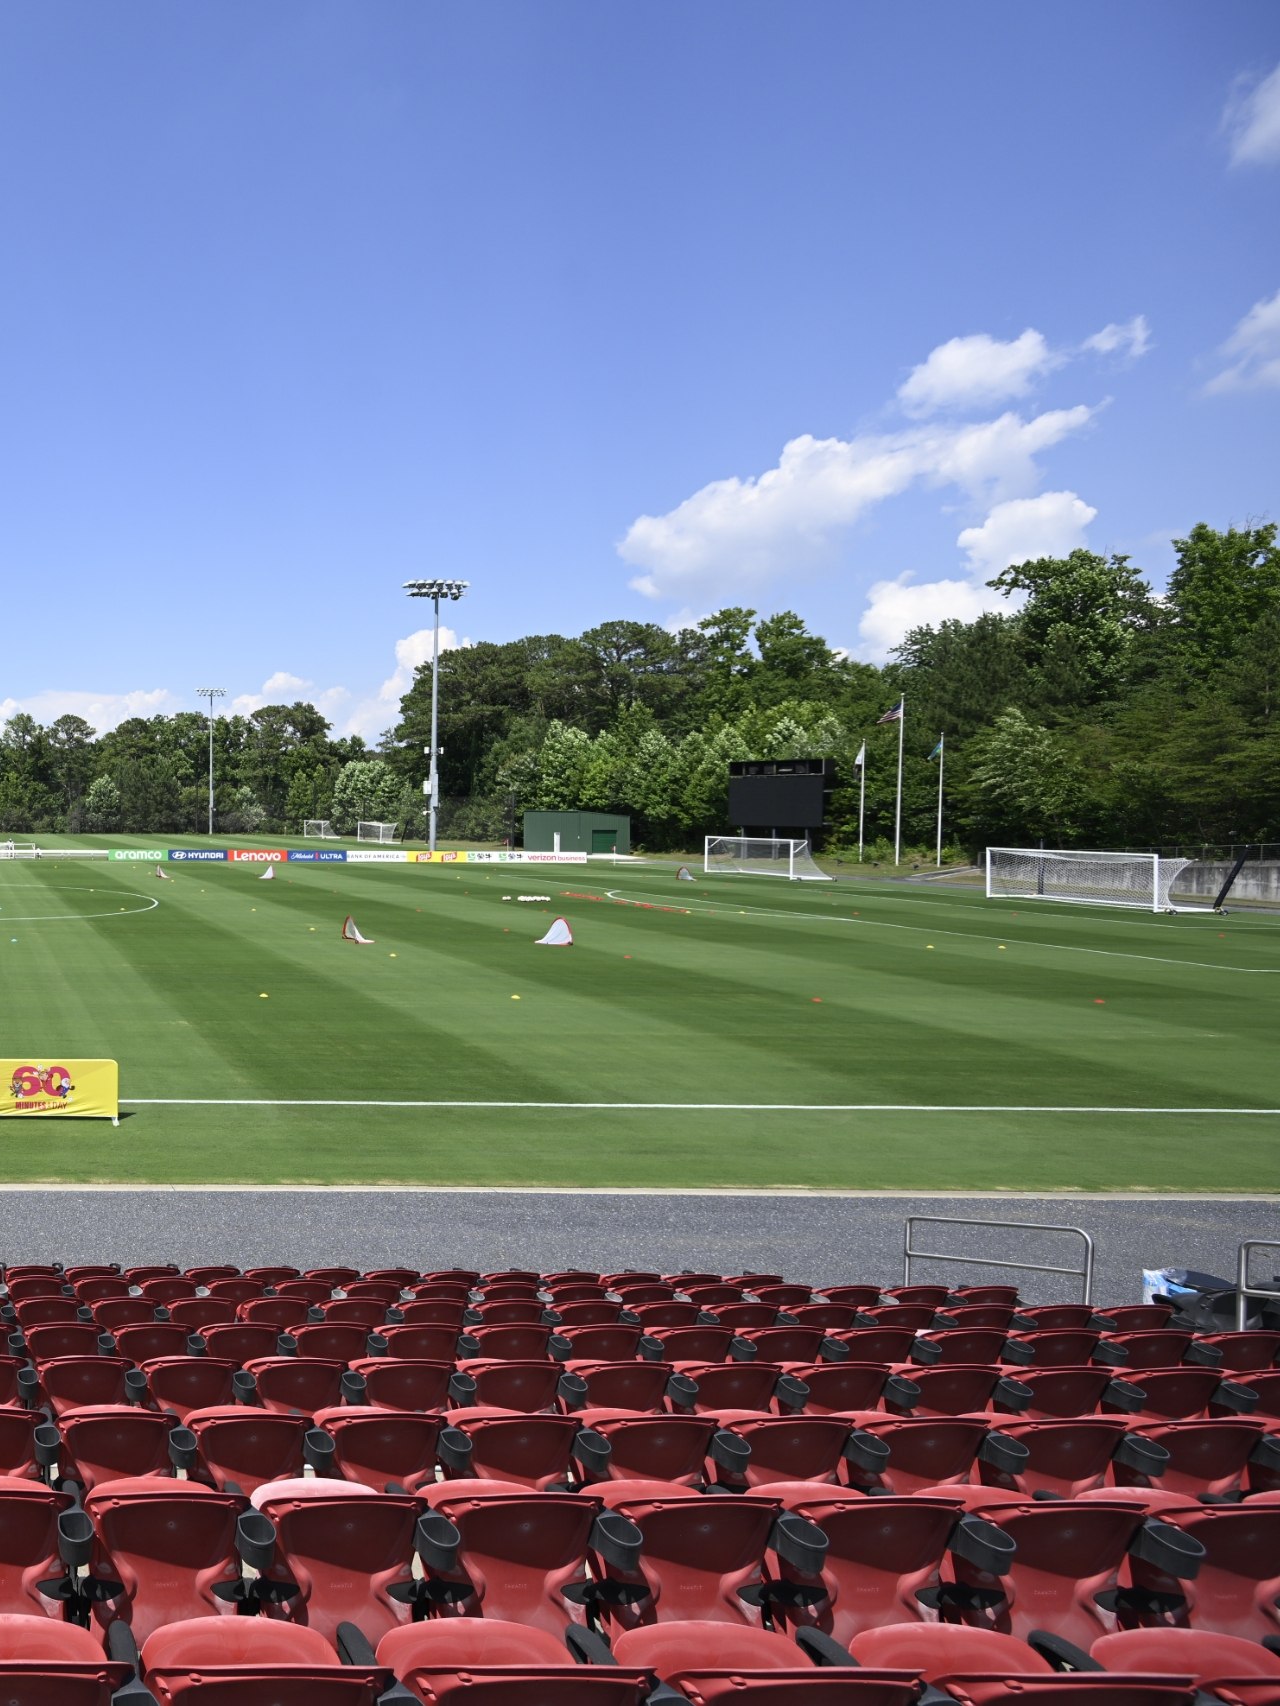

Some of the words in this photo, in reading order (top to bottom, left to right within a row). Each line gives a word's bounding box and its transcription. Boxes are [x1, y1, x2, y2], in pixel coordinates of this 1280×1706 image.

[115, 851, 162, 860] aramco
[233, 850, 281, 861] Lenovo
[12, 1066, 71, 1097] 60
[15, 1101, 46, 1110] MINUTES
